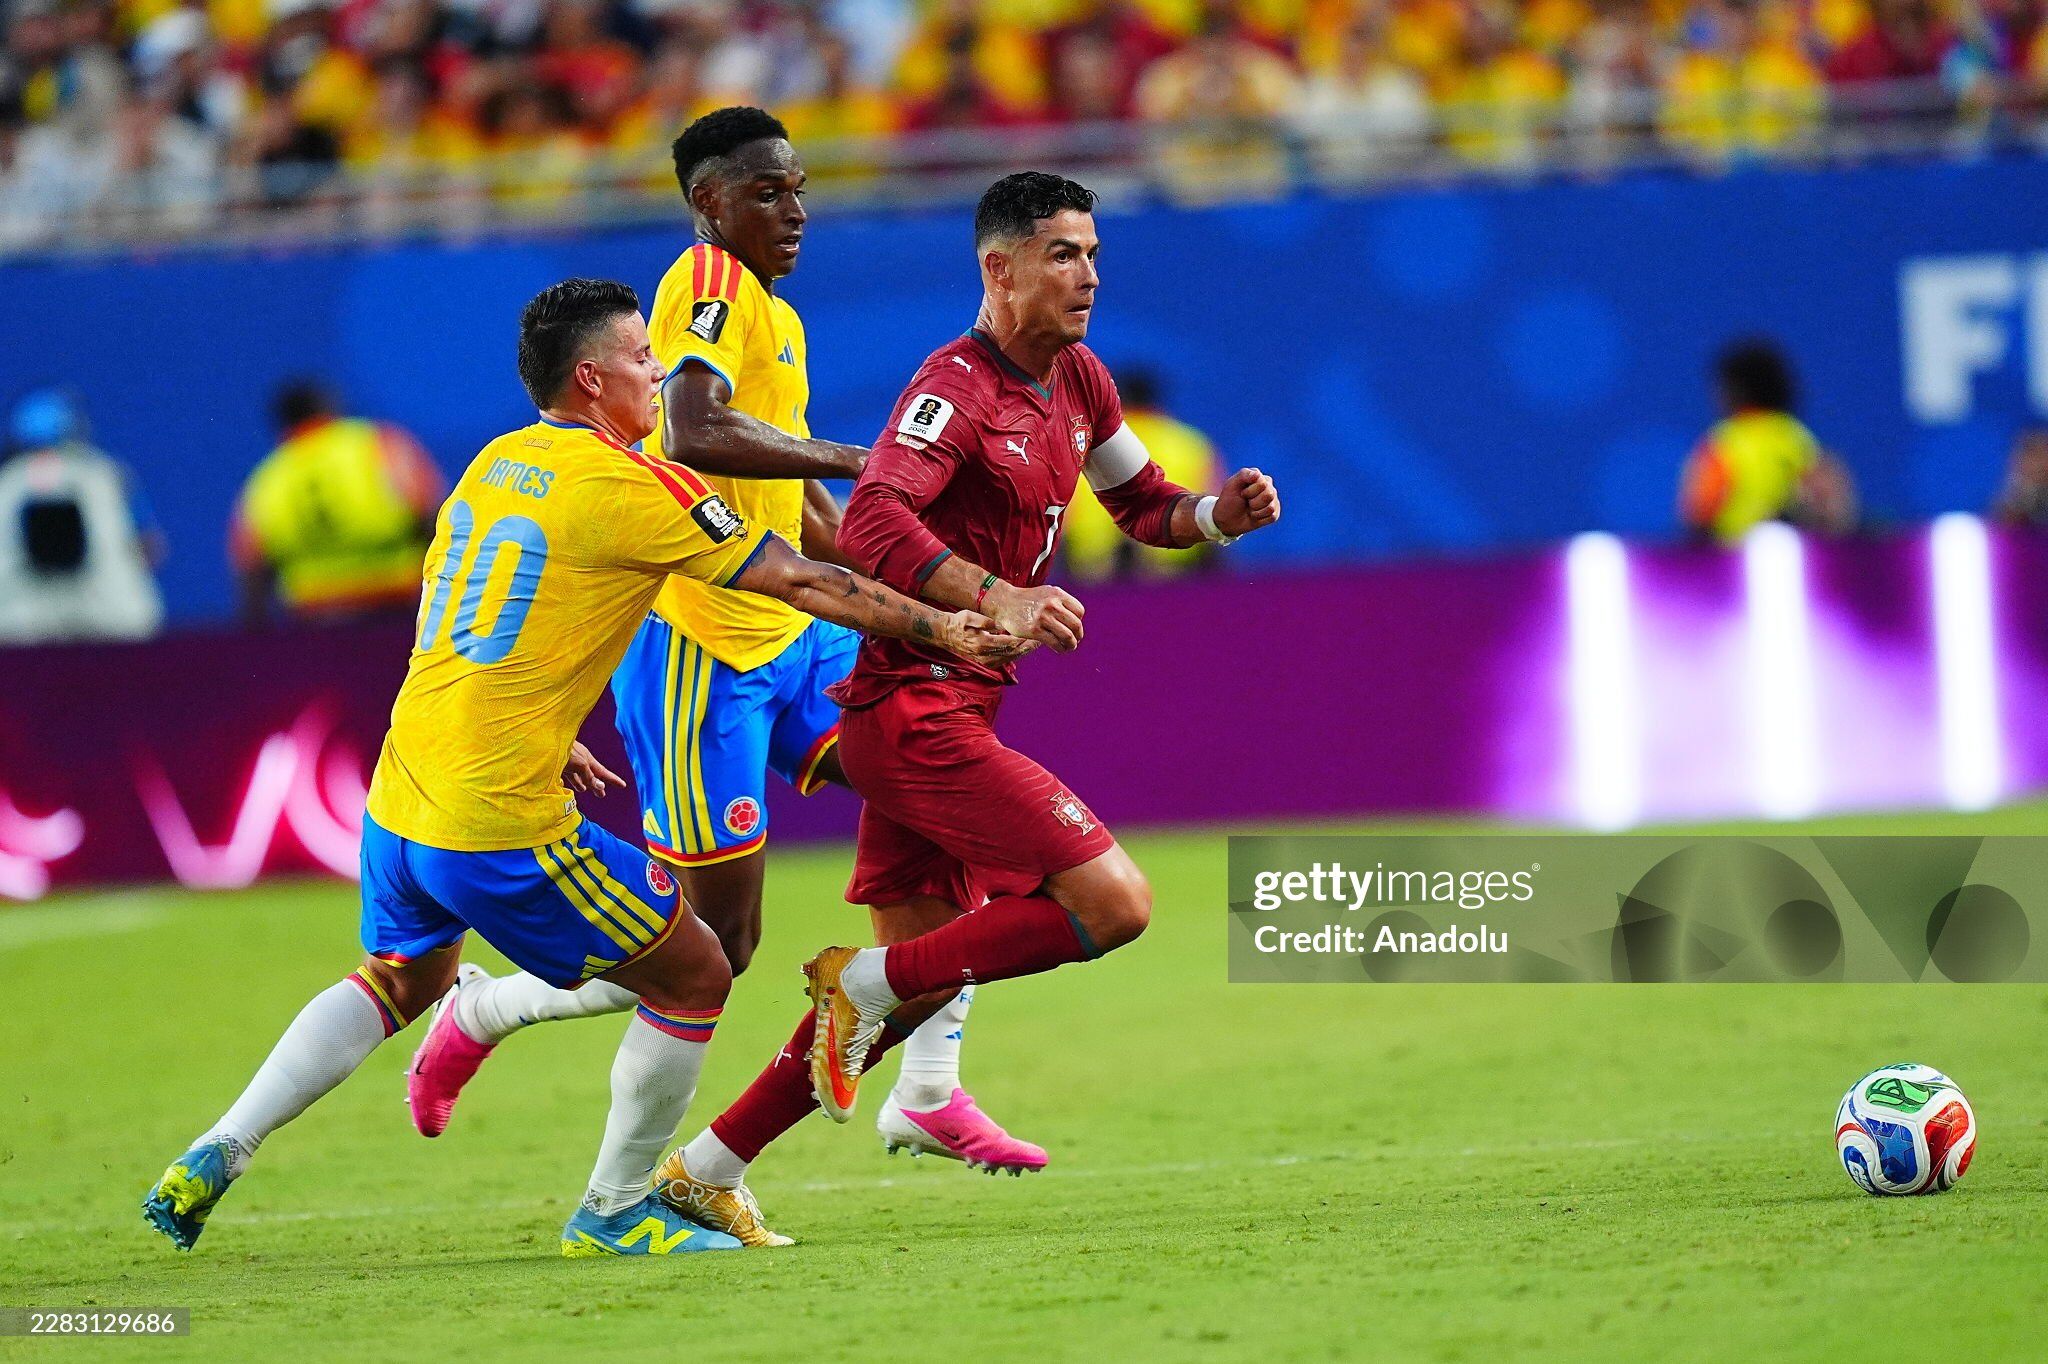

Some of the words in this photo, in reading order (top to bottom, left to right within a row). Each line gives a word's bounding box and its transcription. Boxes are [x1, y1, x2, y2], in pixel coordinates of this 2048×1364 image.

[480, 456, 555, 498] JAMES
[1032, 505, 1066, 576] 7
[421, 500, 548, 664] 10
[668, 1178, 720, 1208] CR7
